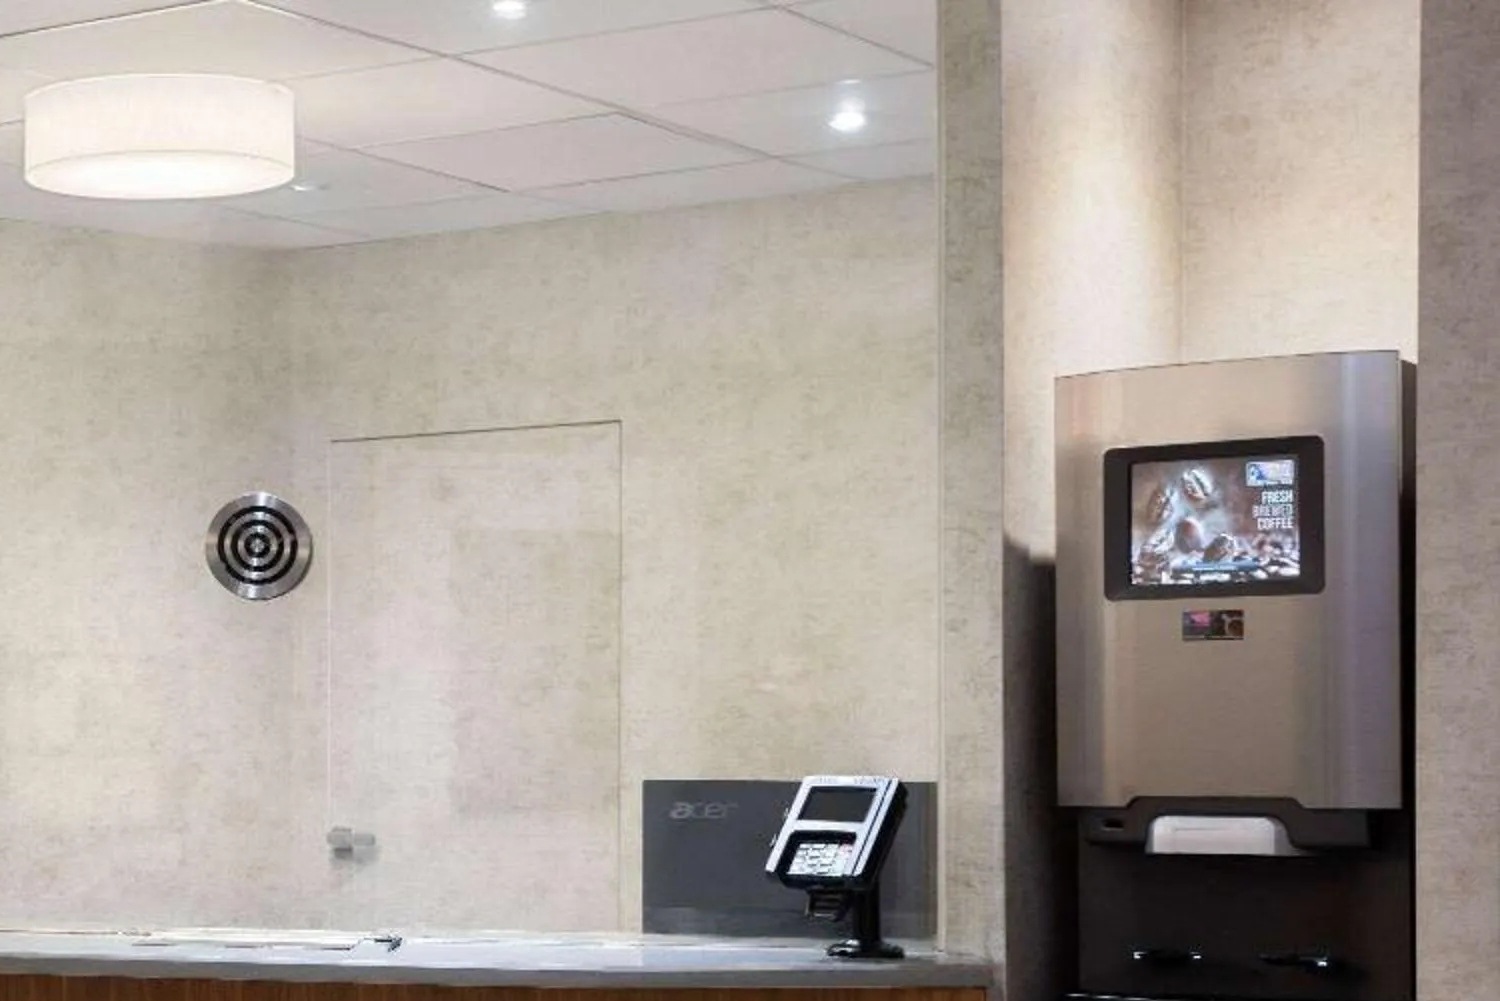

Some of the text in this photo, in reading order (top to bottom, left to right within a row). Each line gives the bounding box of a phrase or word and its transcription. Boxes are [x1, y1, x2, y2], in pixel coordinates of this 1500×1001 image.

[1261, 491, 1293, 505] FRESH
[1257, 517, 1294, 530] COFFEE
[669, 801, 739, 819] acer
